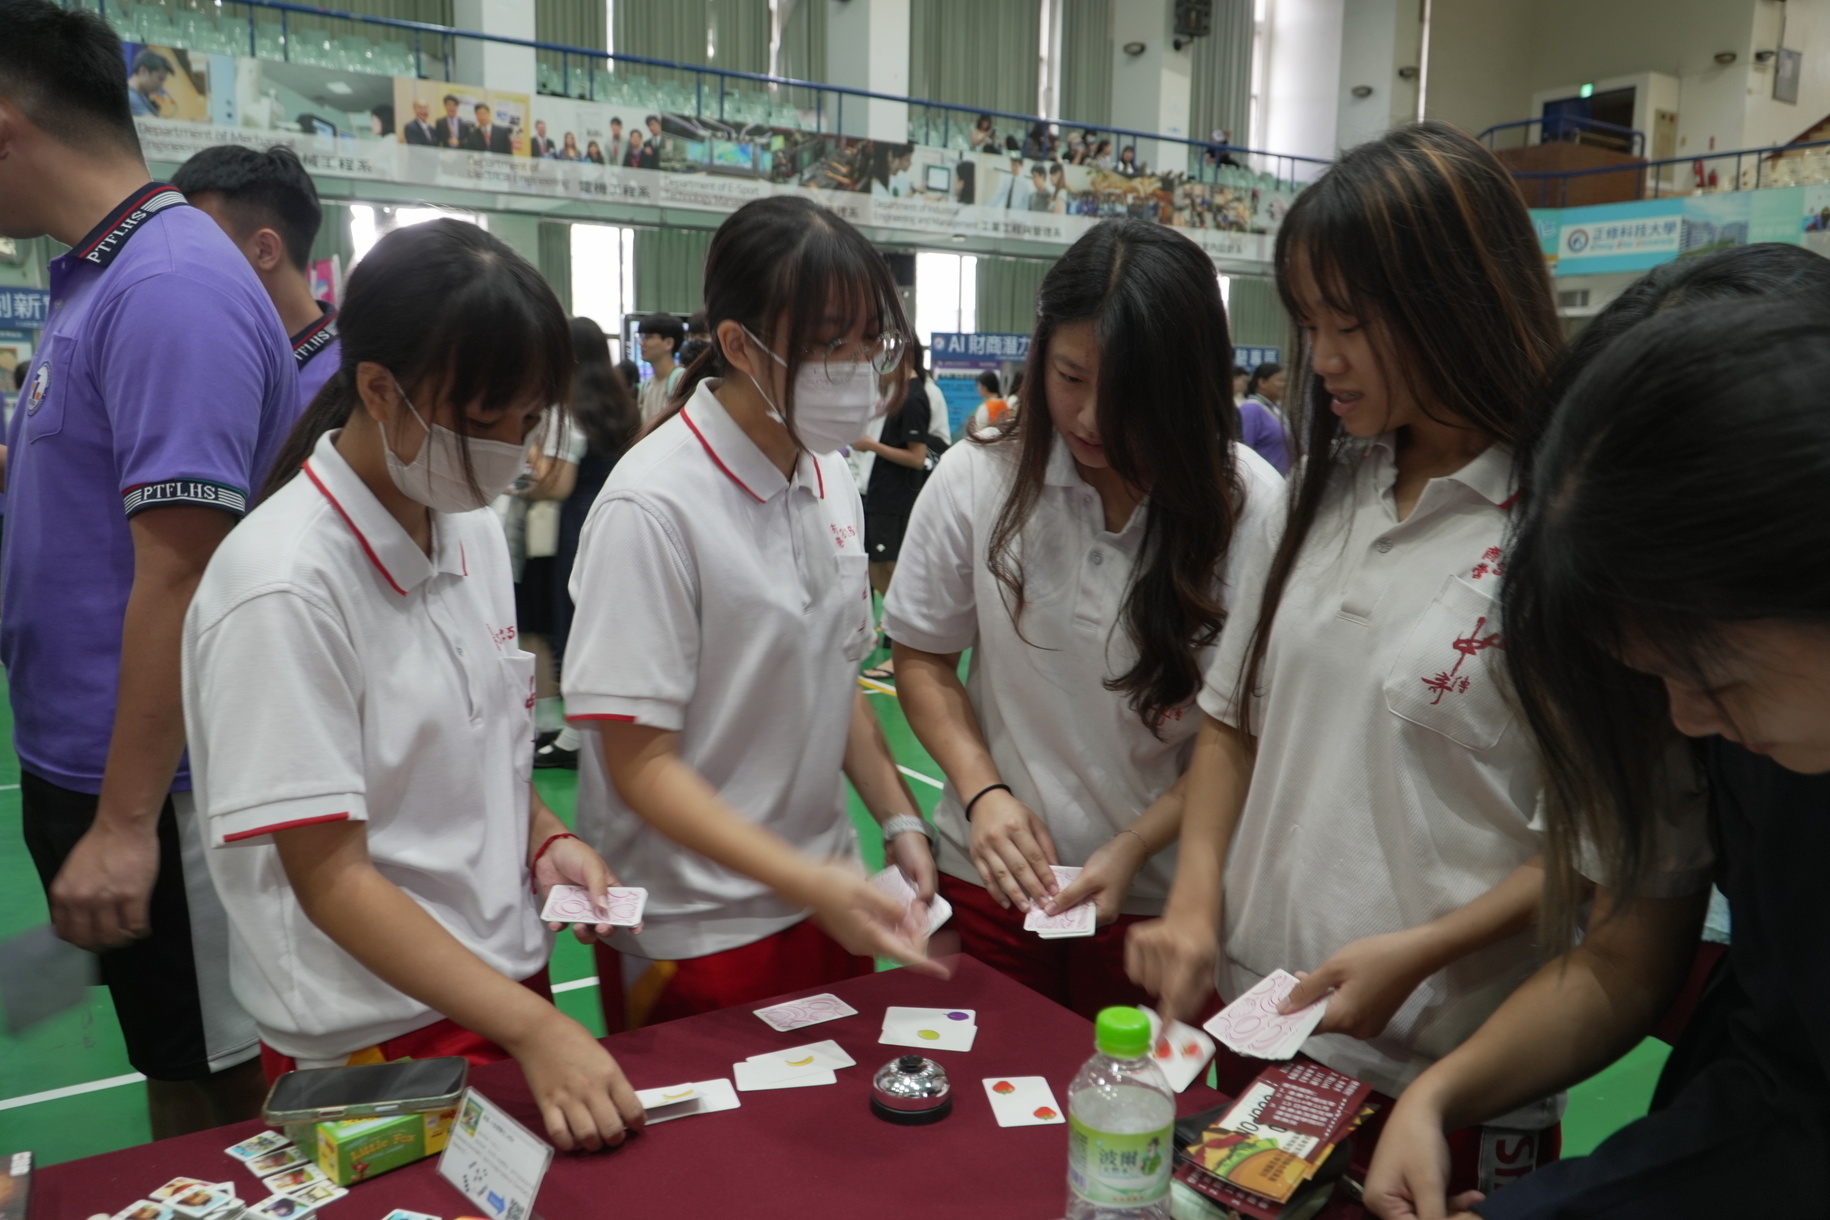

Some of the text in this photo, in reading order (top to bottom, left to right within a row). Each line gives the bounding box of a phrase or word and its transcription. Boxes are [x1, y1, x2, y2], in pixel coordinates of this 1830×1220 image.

[86, 210, 147, 264] PTFLHS
[1593, 220, 1676, 240] 正修科技大學
[948, 335, 965, 353] AI
[143, 482, 216, 501] PTFLHS
[351, 1140, 388, 1161] Little
[393, 1133, 416, 1145] Fox
[1099, 1149, 1138, 1166] 波爾
